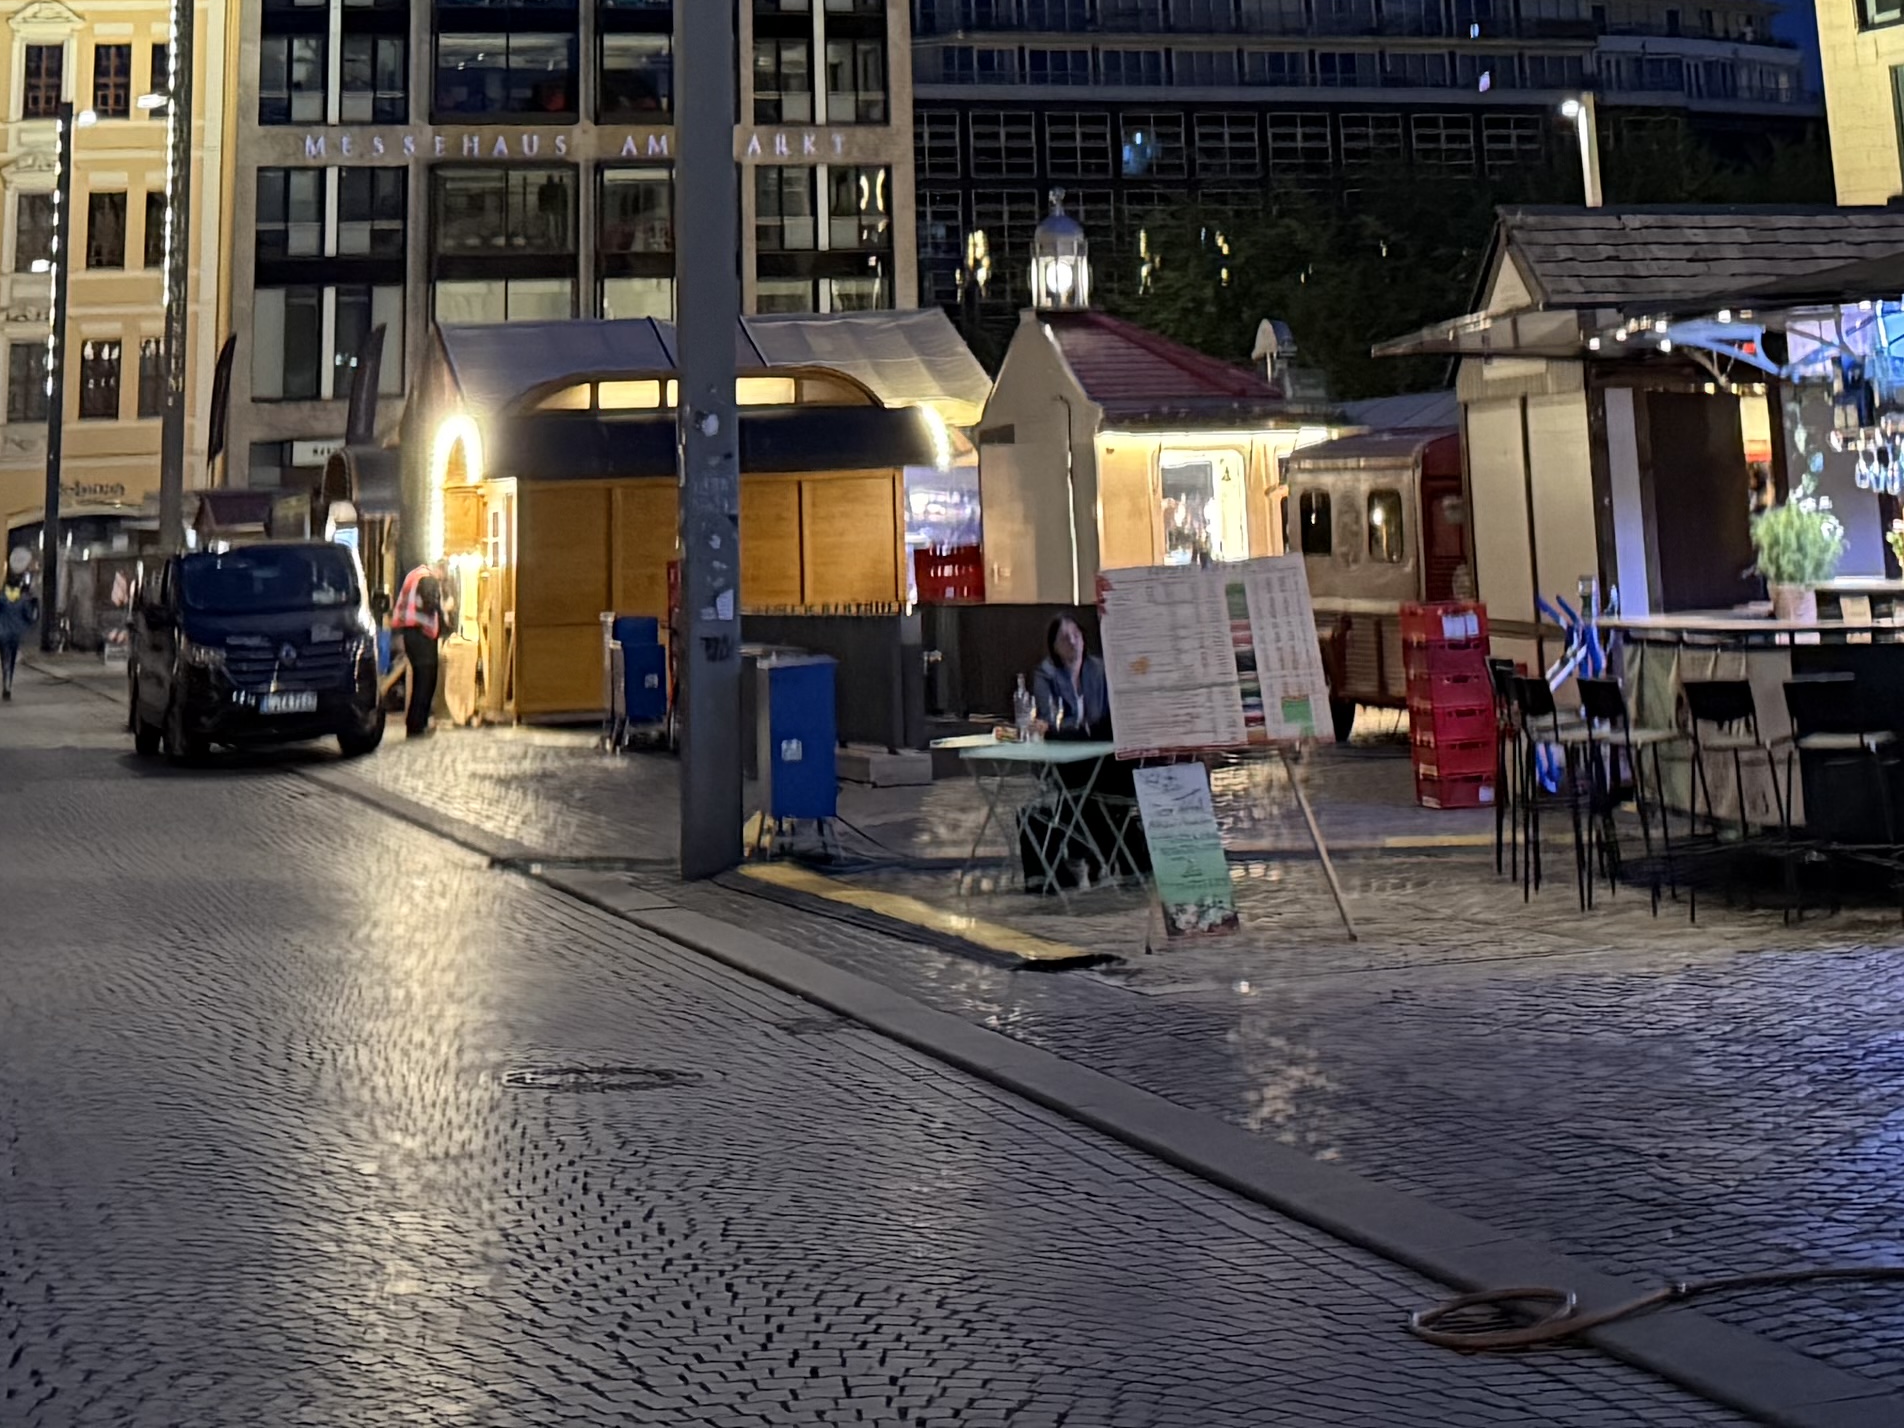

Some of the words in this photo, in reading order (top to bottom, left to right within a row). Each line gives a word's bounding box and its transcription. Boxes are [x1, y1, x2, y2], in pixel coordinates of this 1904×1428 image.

[304, 133, 568, 157] MESSEHAUS
[620, 134, 669, 157] AM
[746, 132, 846, 158] ARKT
